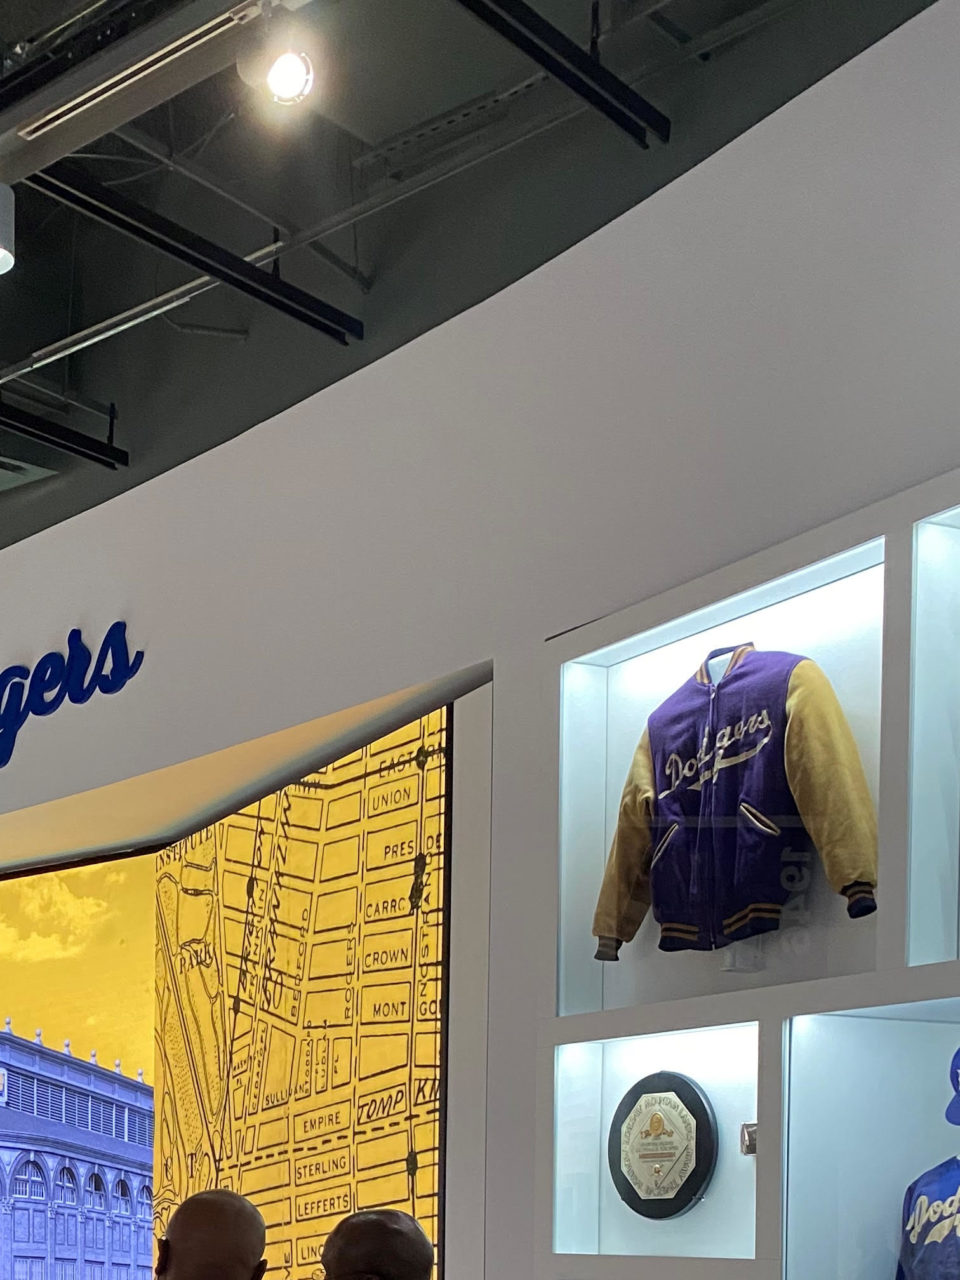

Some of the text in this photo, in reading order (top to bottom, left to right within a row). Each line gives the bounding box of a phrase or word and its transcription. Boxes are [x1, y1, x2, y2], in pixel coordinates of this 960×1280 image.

[658, 709, 773, 800] Dodgers
[372, 787, 411, 811] UNION
[384, 840, 414, 861] PRES
[291, 908, 309, 1018] BEDFORD
[365, 948, 409, 968] CROWN
[373, 1001, 406, 1019] MONT
[357, 1089, 404, 1125] TOMP
[303, 1111, 341, 1133] EMPIRE
[296, 1156, 347, 1180] STERLING
[297, 1194, 349, 1217] LEFFERTS
